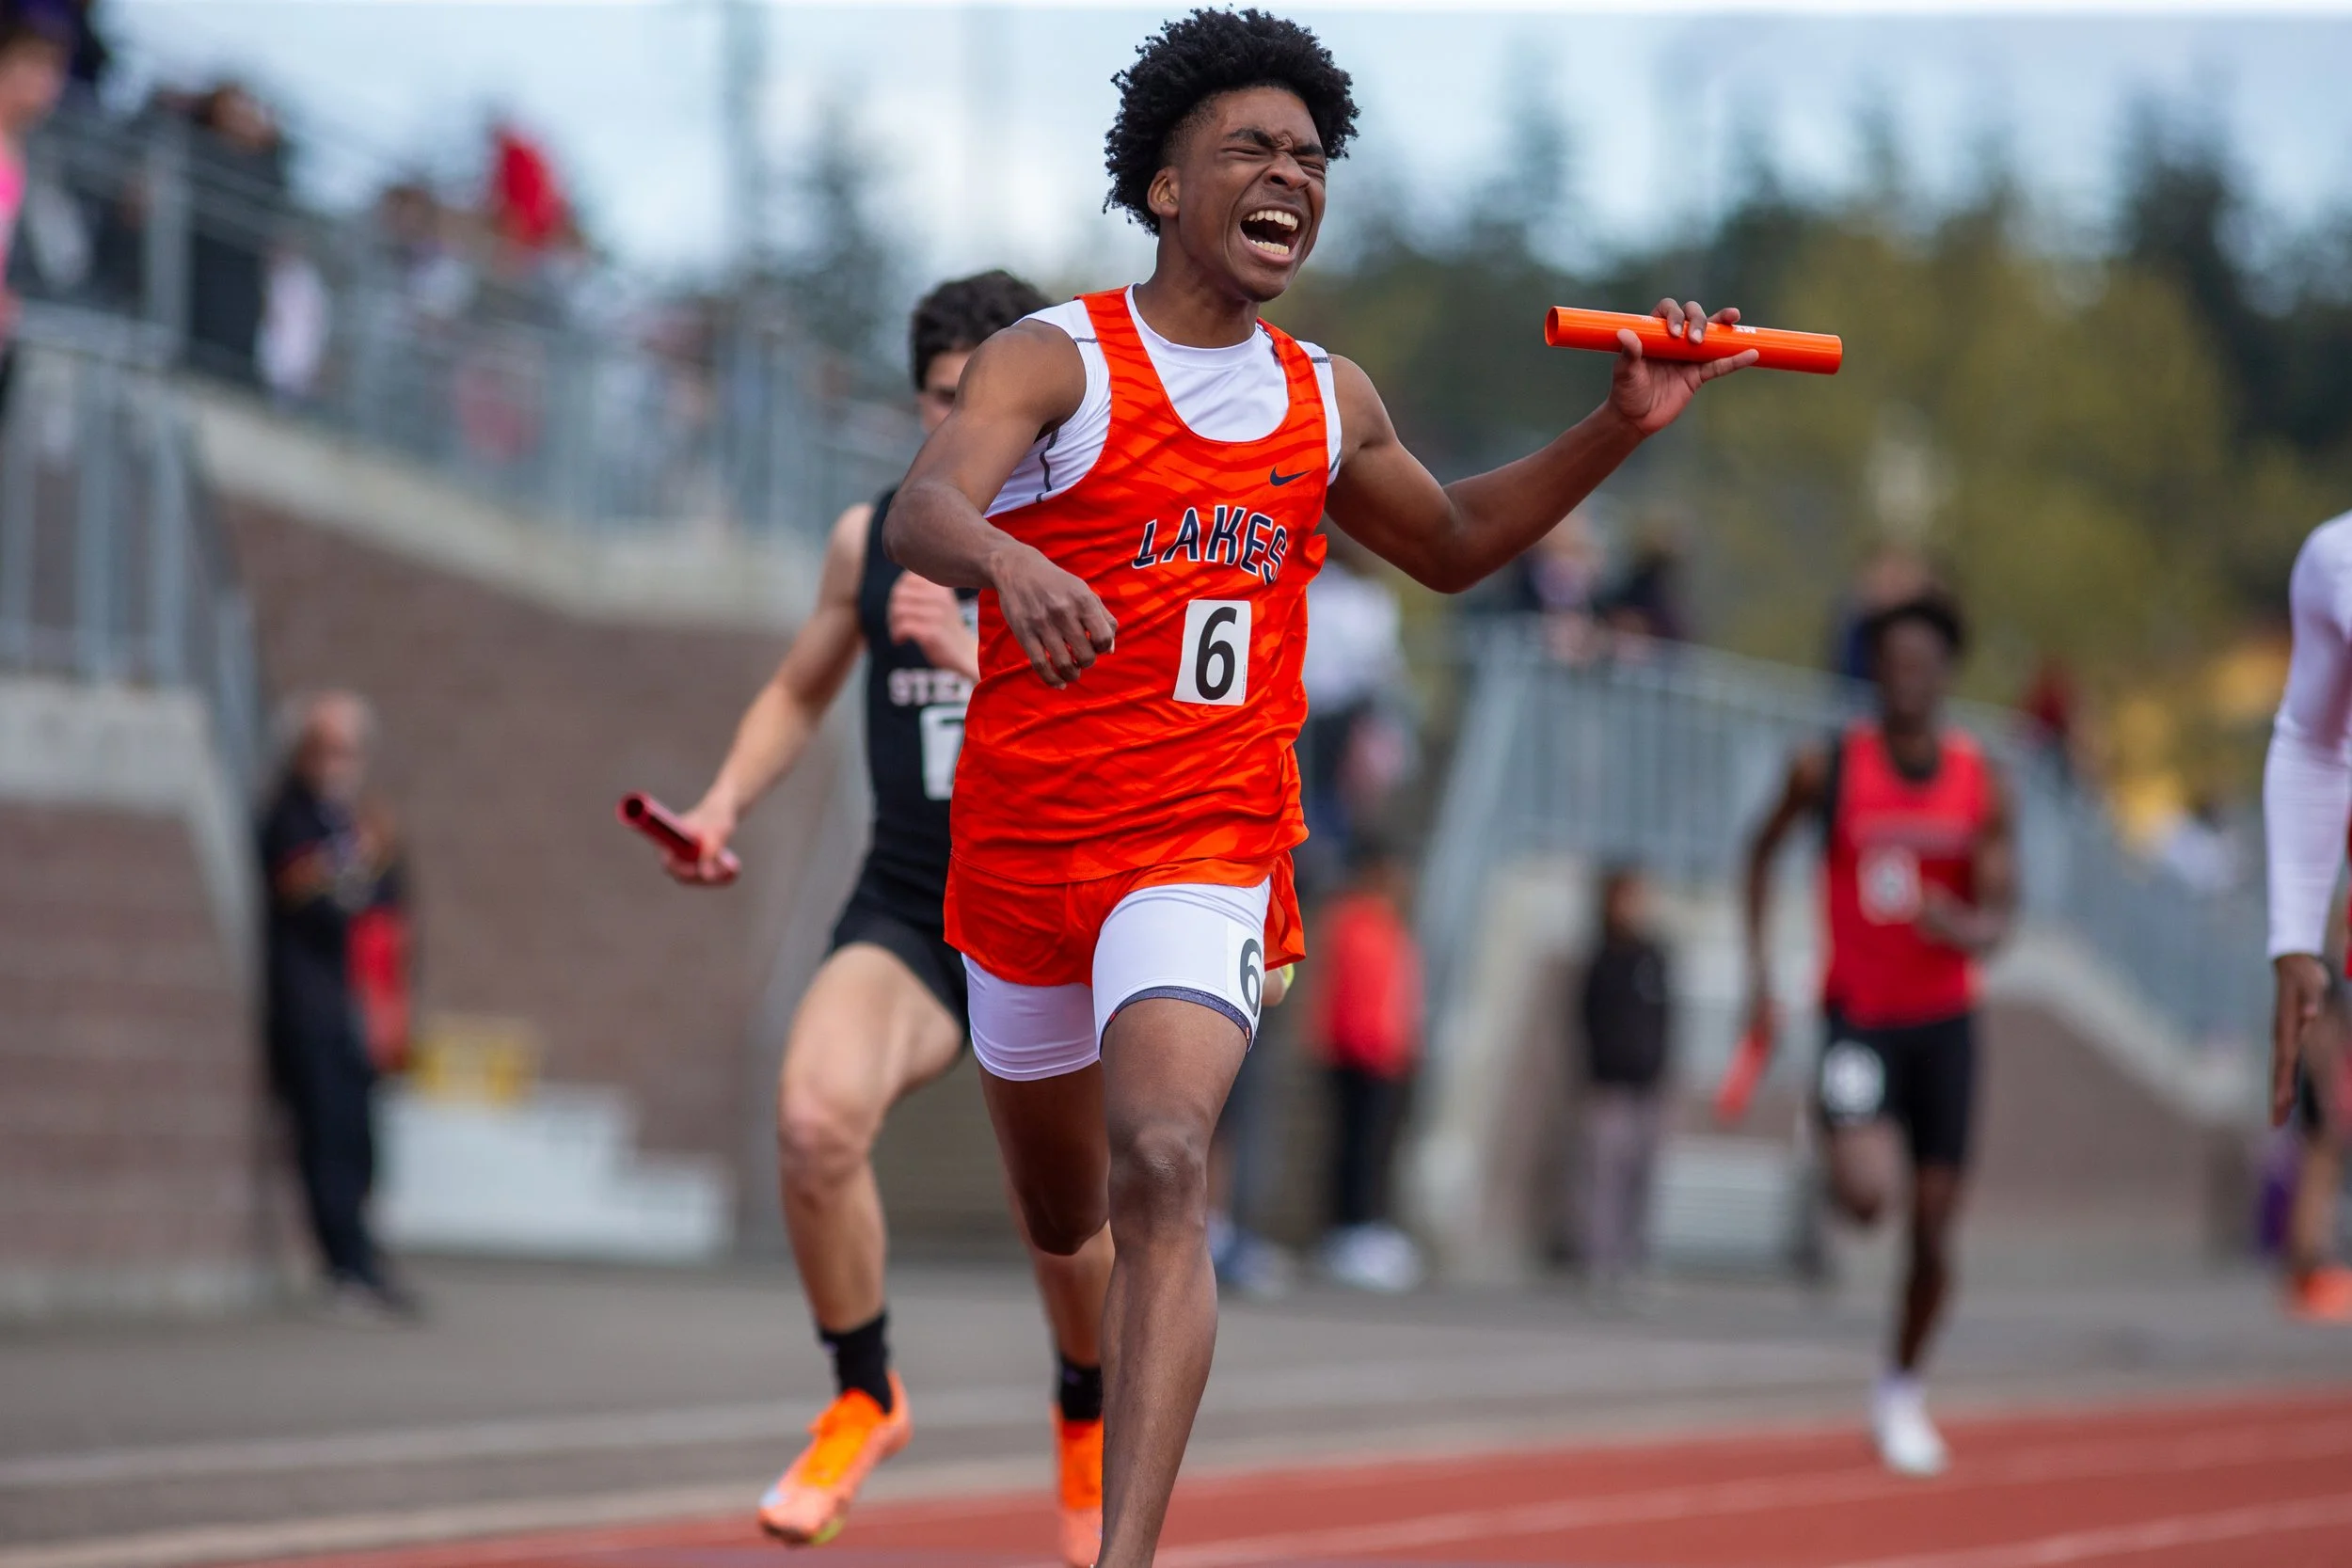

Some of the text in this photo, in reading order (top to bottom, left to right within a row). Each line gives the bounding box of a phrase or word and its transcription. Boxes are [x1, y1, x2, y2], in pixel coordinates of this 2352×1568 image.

[1132, 504, 1287, 586] LAKES
[1195, 606, 1238, 701] 6
[1239, 938, 1263, 1018] 6
